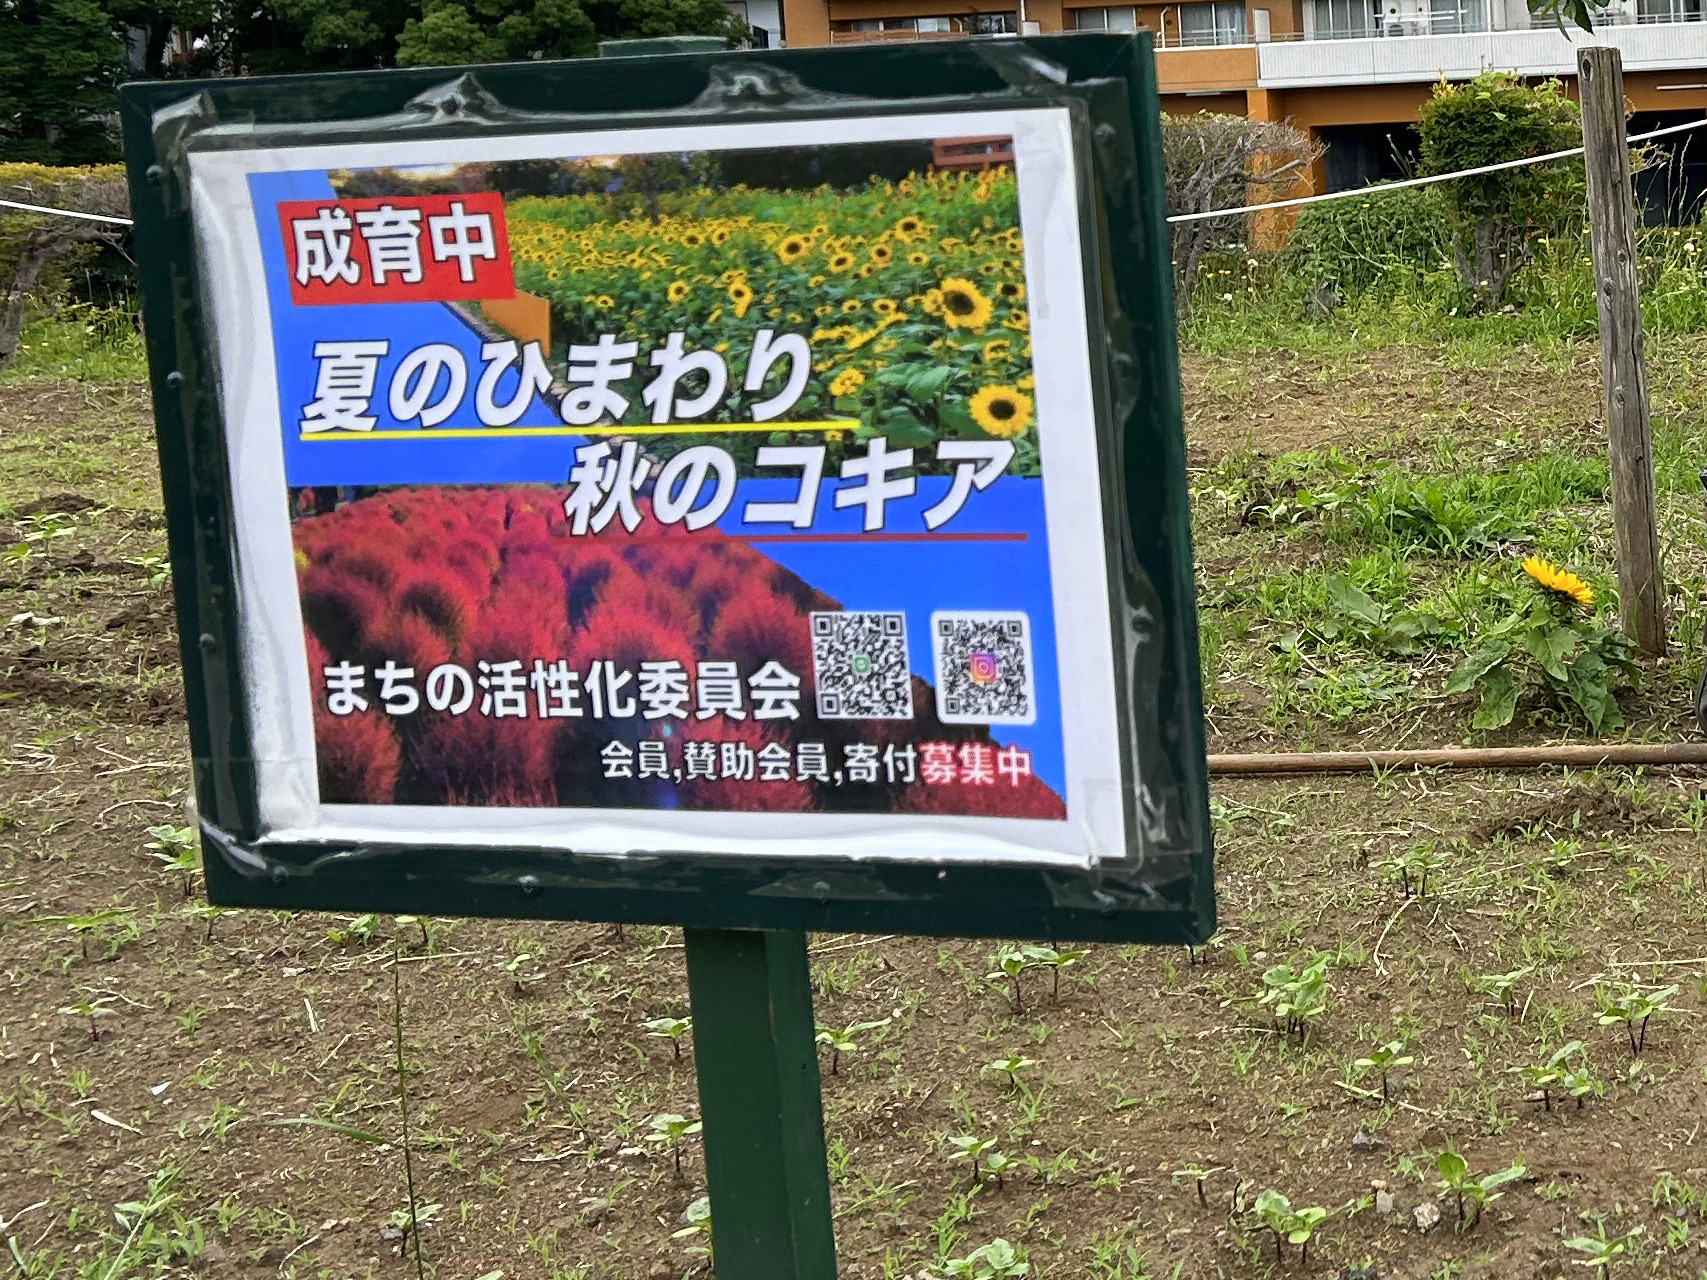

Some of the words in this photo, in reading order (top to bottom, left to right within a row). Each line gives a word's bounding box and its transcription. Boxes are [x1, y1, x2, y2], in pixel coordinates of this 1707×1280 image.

[293, 201, 498, 286] 成育中
[299, 328, 815, 434] 夏のひまわり
[564, 437, 1015, 538] 秋のコキア
[323, 660, 801, 721] まちの活性化委員会
